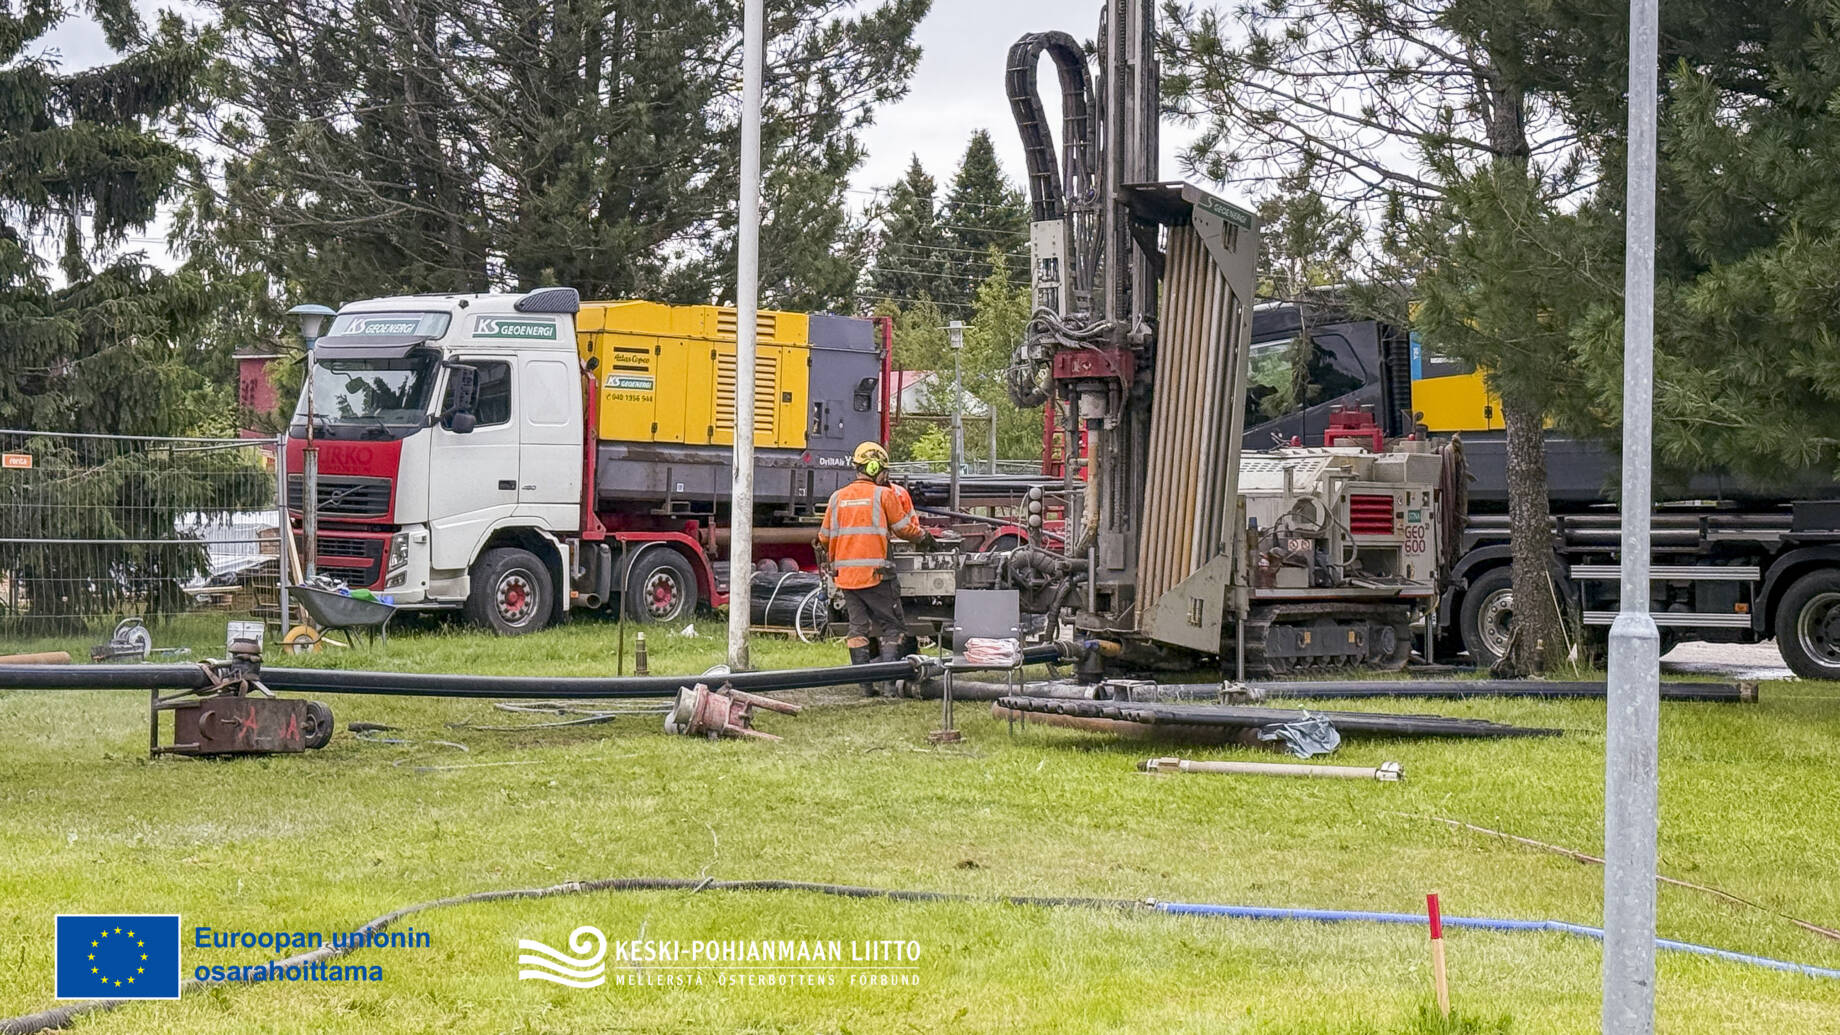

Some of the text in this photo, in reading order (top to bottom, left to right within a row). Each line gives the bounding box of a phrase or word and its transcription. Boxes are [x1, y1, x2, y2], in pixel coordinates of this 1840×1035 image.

[1213, 203, 1247, 223] GEOENERGI
[346, 318, 415, 334] KS GEOENERGI
[477, 319, 553, 336] KS GEOENERGI
[606, 376, 652, 388] KS GEOENERGI
[1405, 525, 1425, 539] GEO
[1405, 539, 1426, 553] 600
